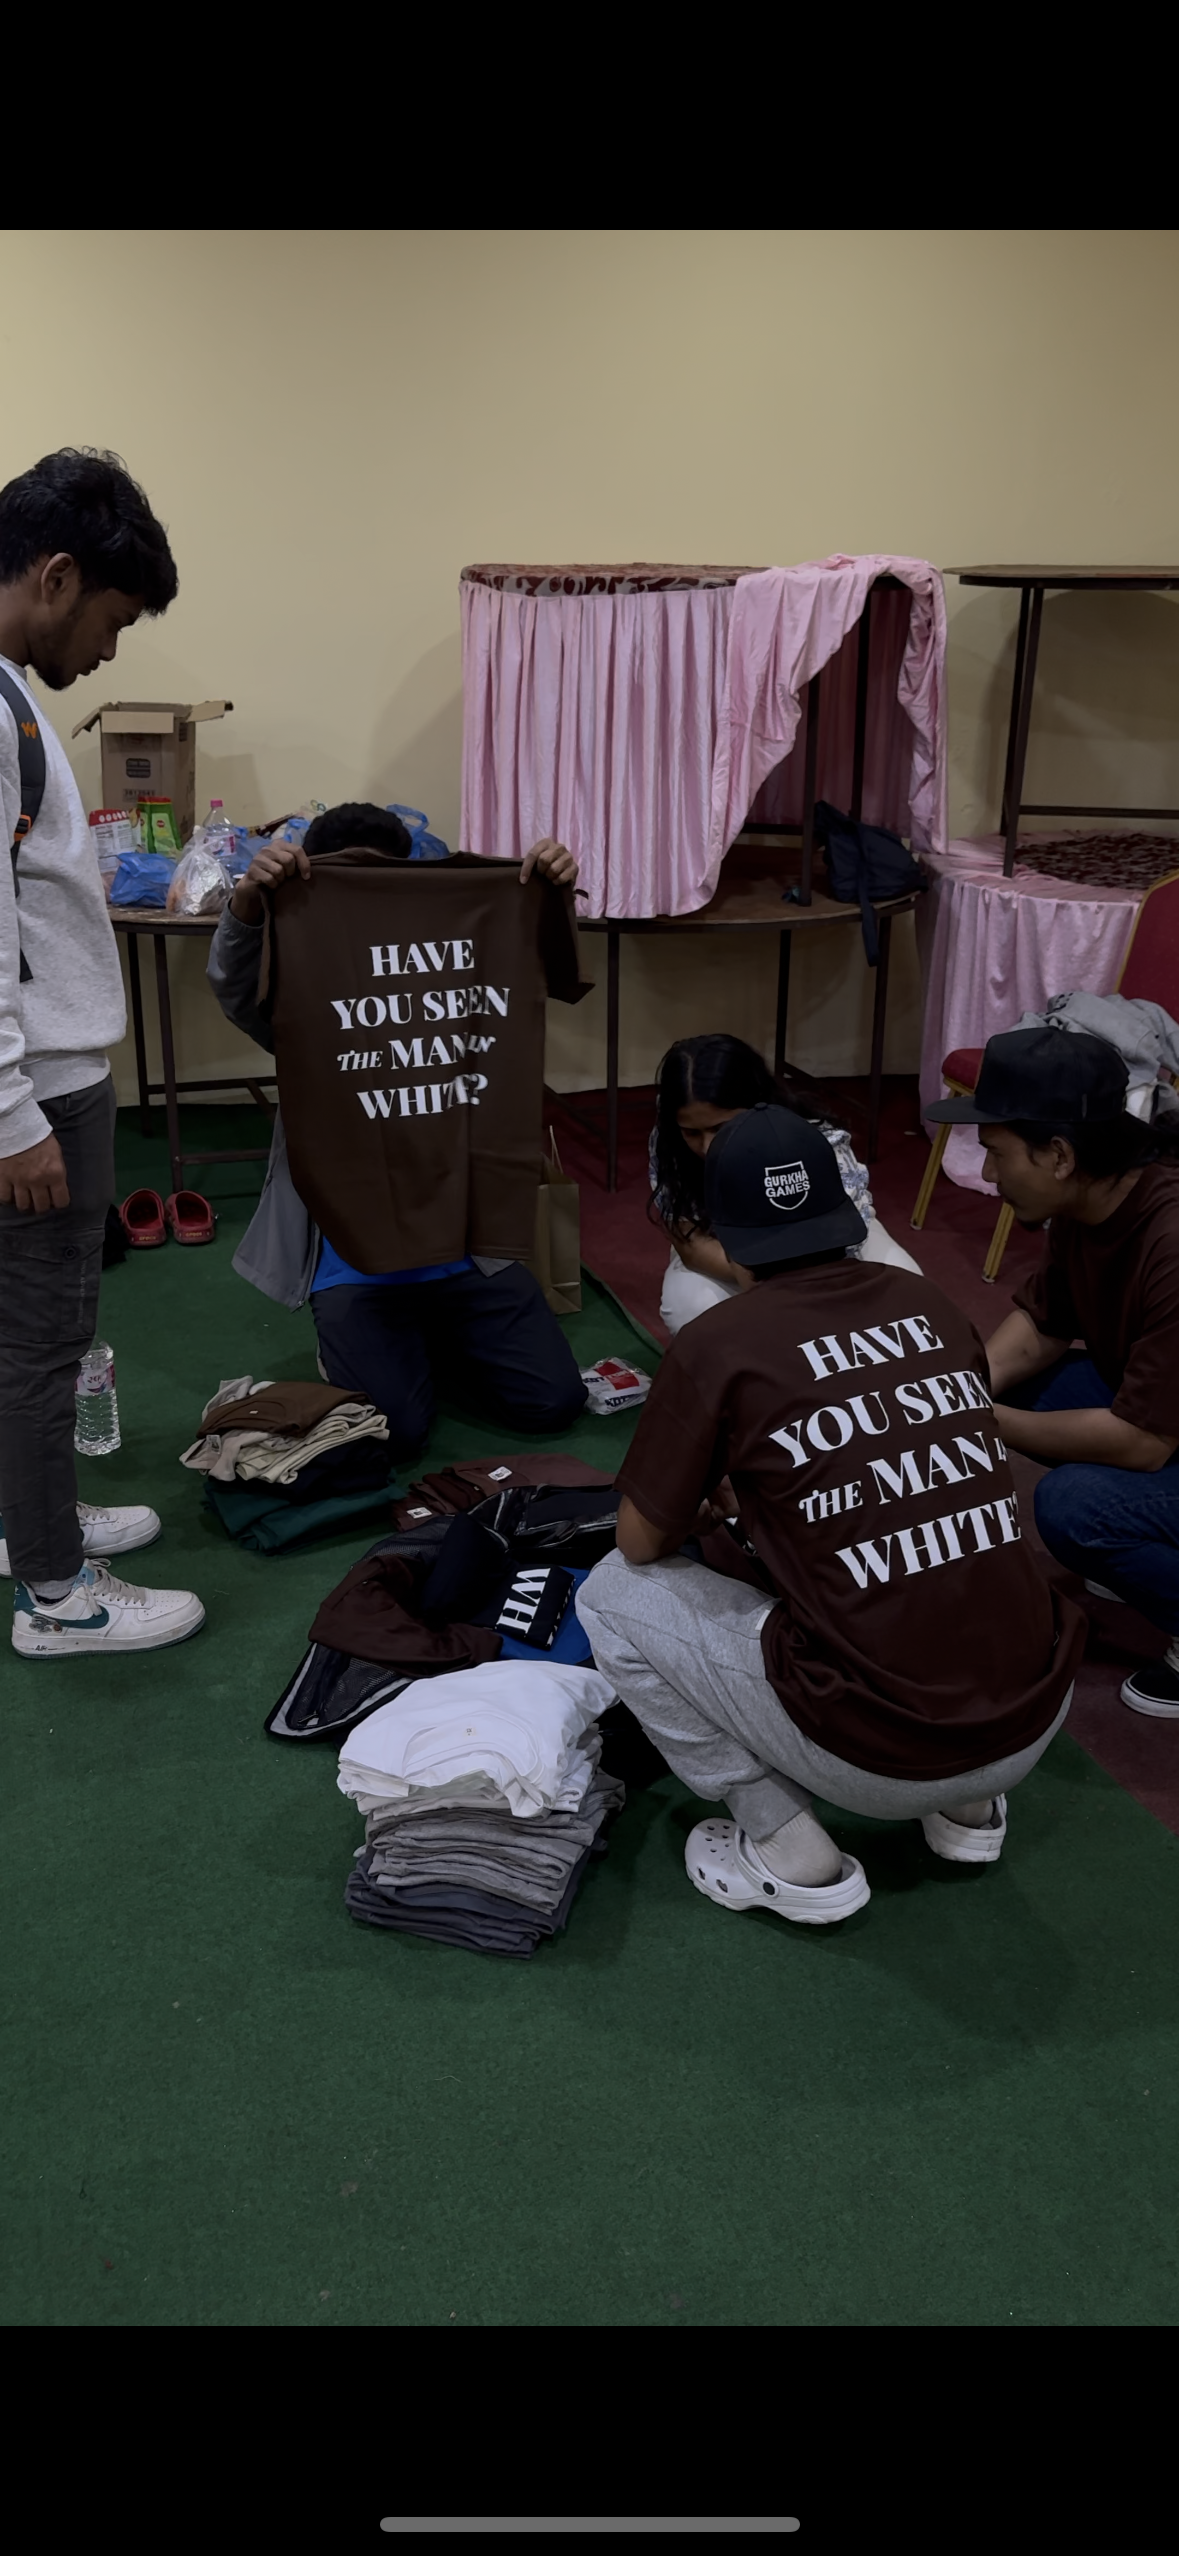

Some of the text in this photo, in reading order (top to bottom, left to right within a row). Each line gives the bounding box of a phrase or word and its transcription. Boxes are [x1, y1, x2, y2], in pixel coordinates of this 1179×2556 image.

[369, 939, 475, 977] HAVE
[330, 985, 510, 1030] YOU SEEN
[336, 1031, 497, 1071] THE MAN IN
[356, 1073, 489, 1120] WHITE?
[764, 1169, 809, 1188] GURKHA
[765, 1181, 810, 1198] GAMES
[797, 1314, 945, 1382] HAVE
[768, 1370, 994, 1469] YOU SEEN
[798, 1480, 863, 1523] THE
[866, 1431, 994, 1505] MAN
